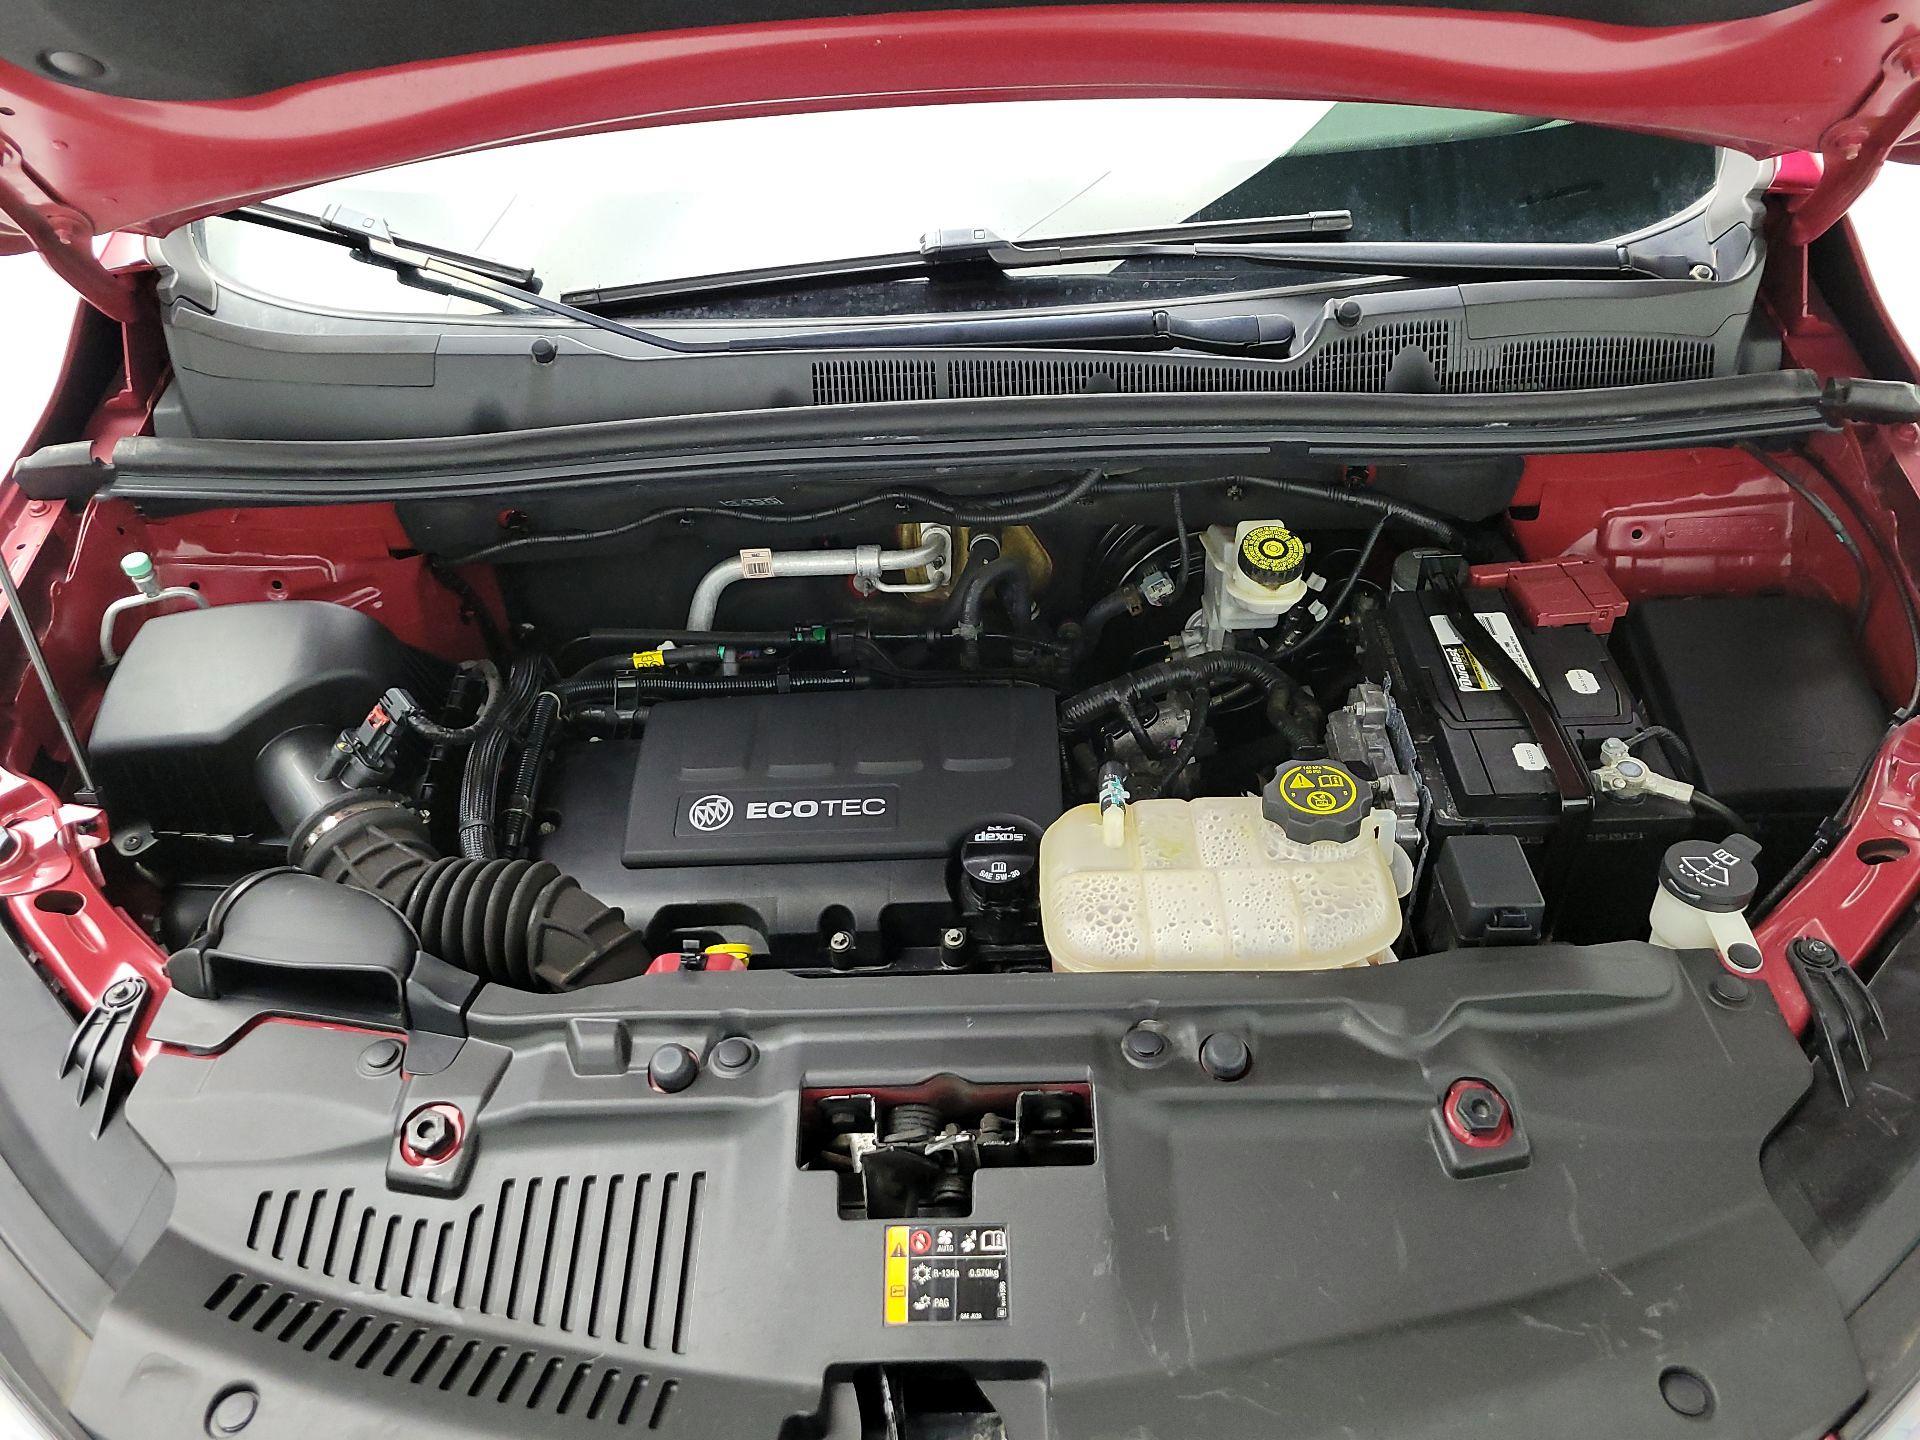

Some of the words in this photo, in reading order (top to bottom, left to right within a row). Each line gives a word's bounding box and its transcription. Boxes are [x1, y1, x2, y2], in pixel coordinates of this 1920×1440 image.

[1445, 647, 1472, 687] Duralast
[746, 798, 886, 819] ECOTEC
[974, 831, 1024, 842] dexos
[979, 869, 993, 880] SAE
[995, 869, 1021, 880] 5W-30
[936, 1244, 954, 1252] AUTO
[932, 1268, 960, 1278] R-134a
[934, 1297, 949, 1308] PAG
